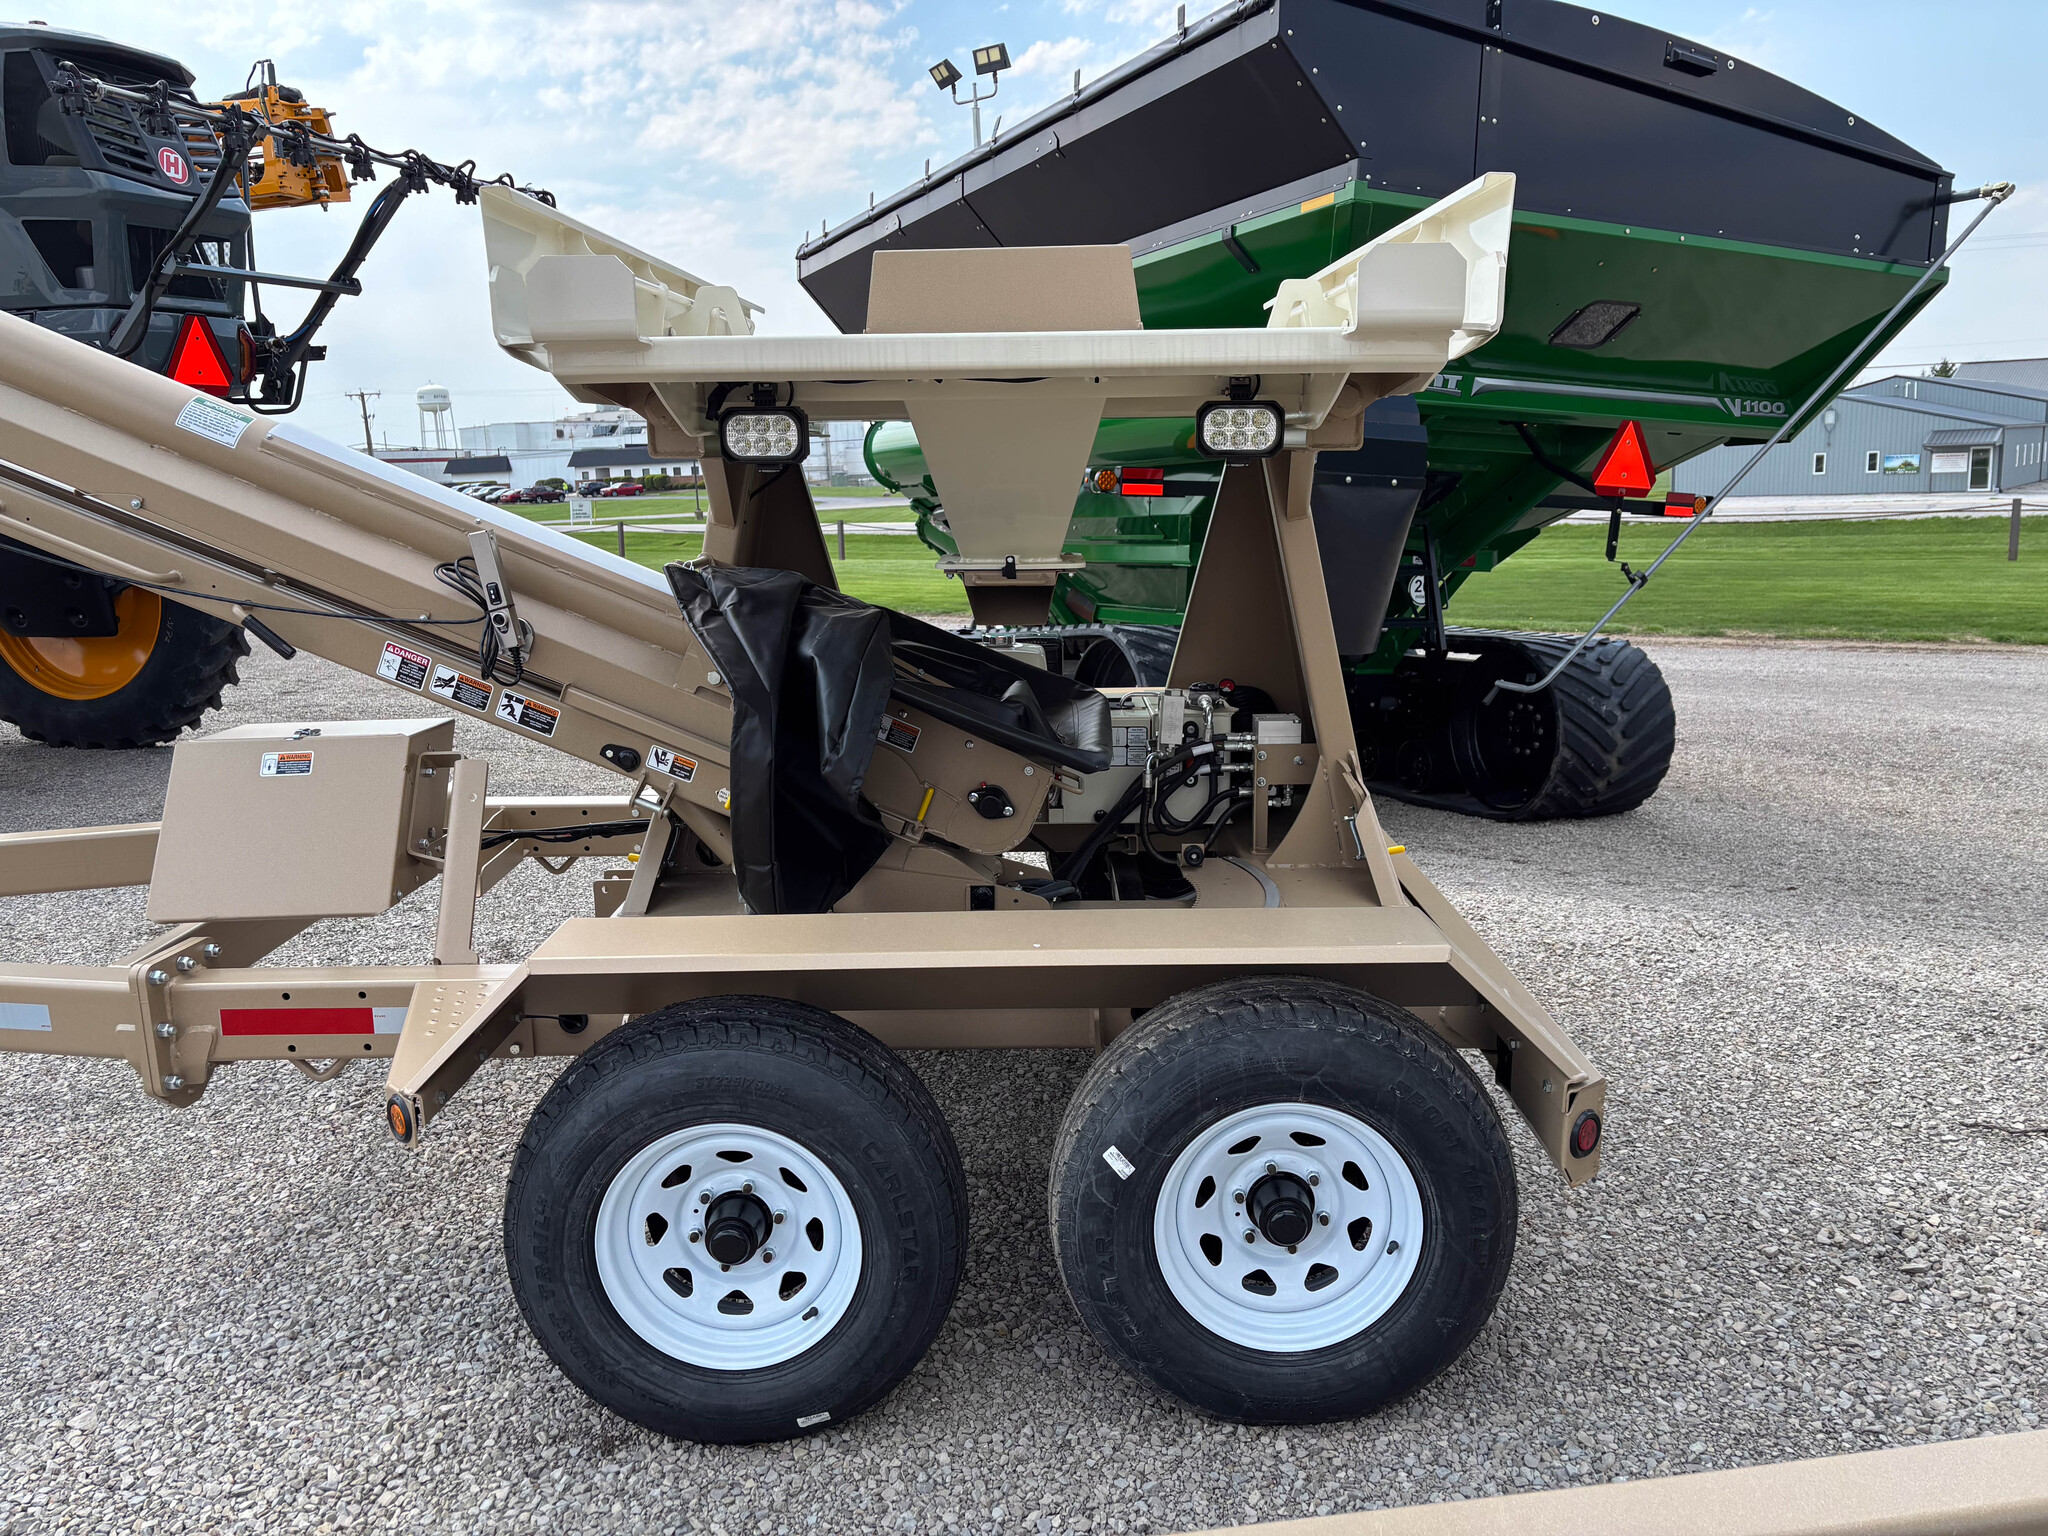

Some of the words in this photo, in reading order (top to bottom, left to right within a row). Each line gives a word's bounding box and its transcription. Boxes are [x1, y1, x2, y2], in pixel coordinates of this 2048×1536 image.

[204, 400, 243, 418] IMPORTANT
[1724, 398, 1786, 417] V1100
[394, 647, 428, 666] DANGER
[464, 677, 490, 691] WARNING
[533, 703, 557, 716] WARNING
[1388, 1079, 1465, 1151] SPORT
[862, 1141, 919, 1282] CARLSTAR
[532, 1216, 556, 1302] TRAIL
[1095, 1237, 1170, 1367] CARLSTAR
